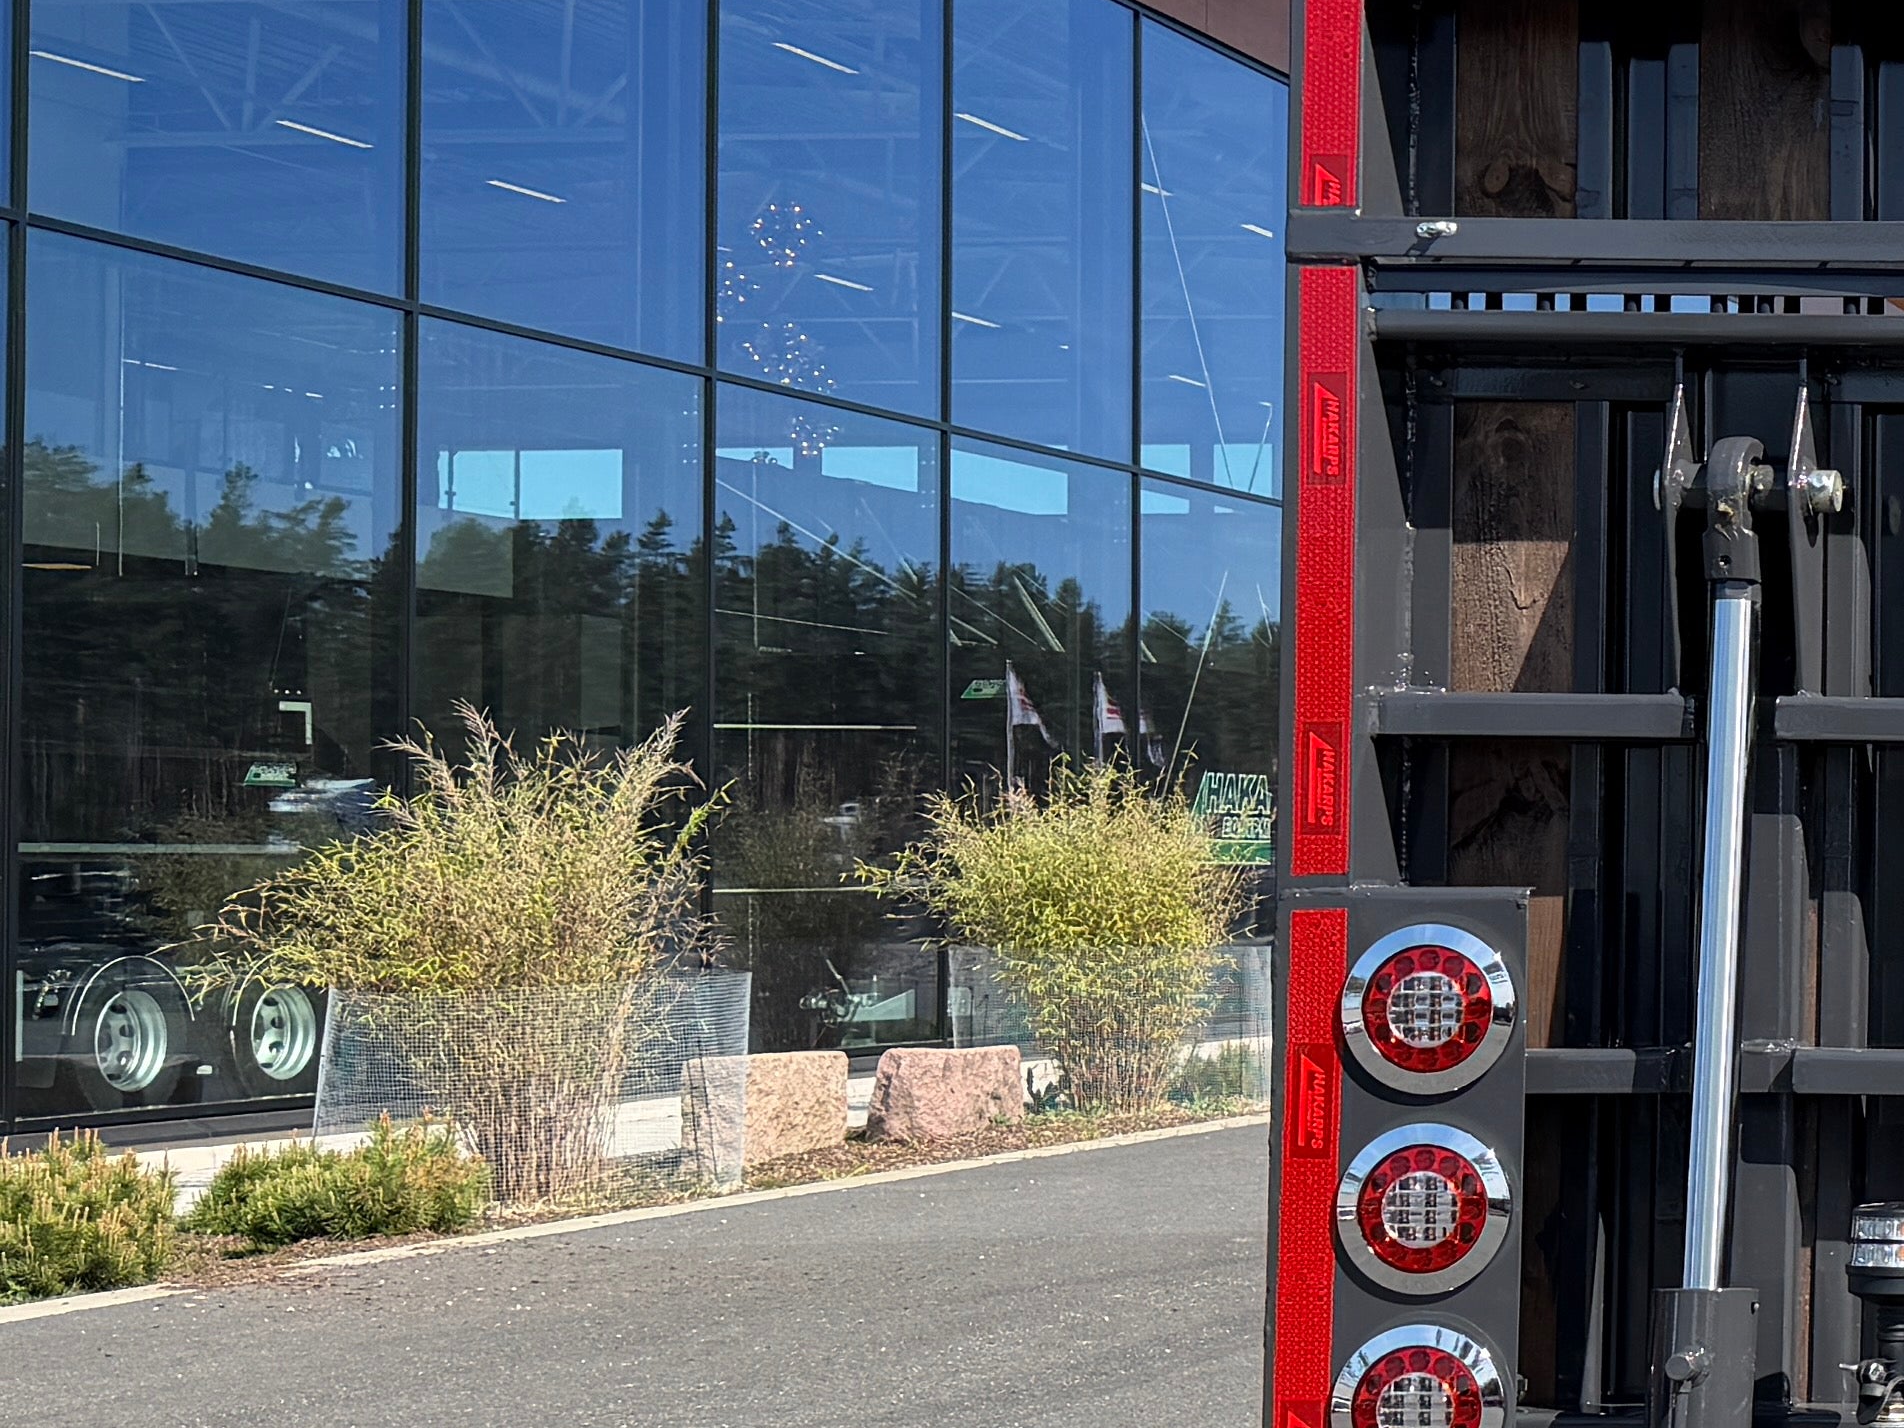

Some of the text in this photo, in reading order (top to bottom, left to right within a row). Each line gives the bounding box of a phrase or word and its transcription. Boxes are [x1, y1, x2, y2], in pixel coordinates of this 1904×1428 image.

[1327, 400, 1340, 475] HAKARPS
[1321, 750, 1335, 826] HAKARPS
[1311, 1074, 1326, 1149] HAKARPS
